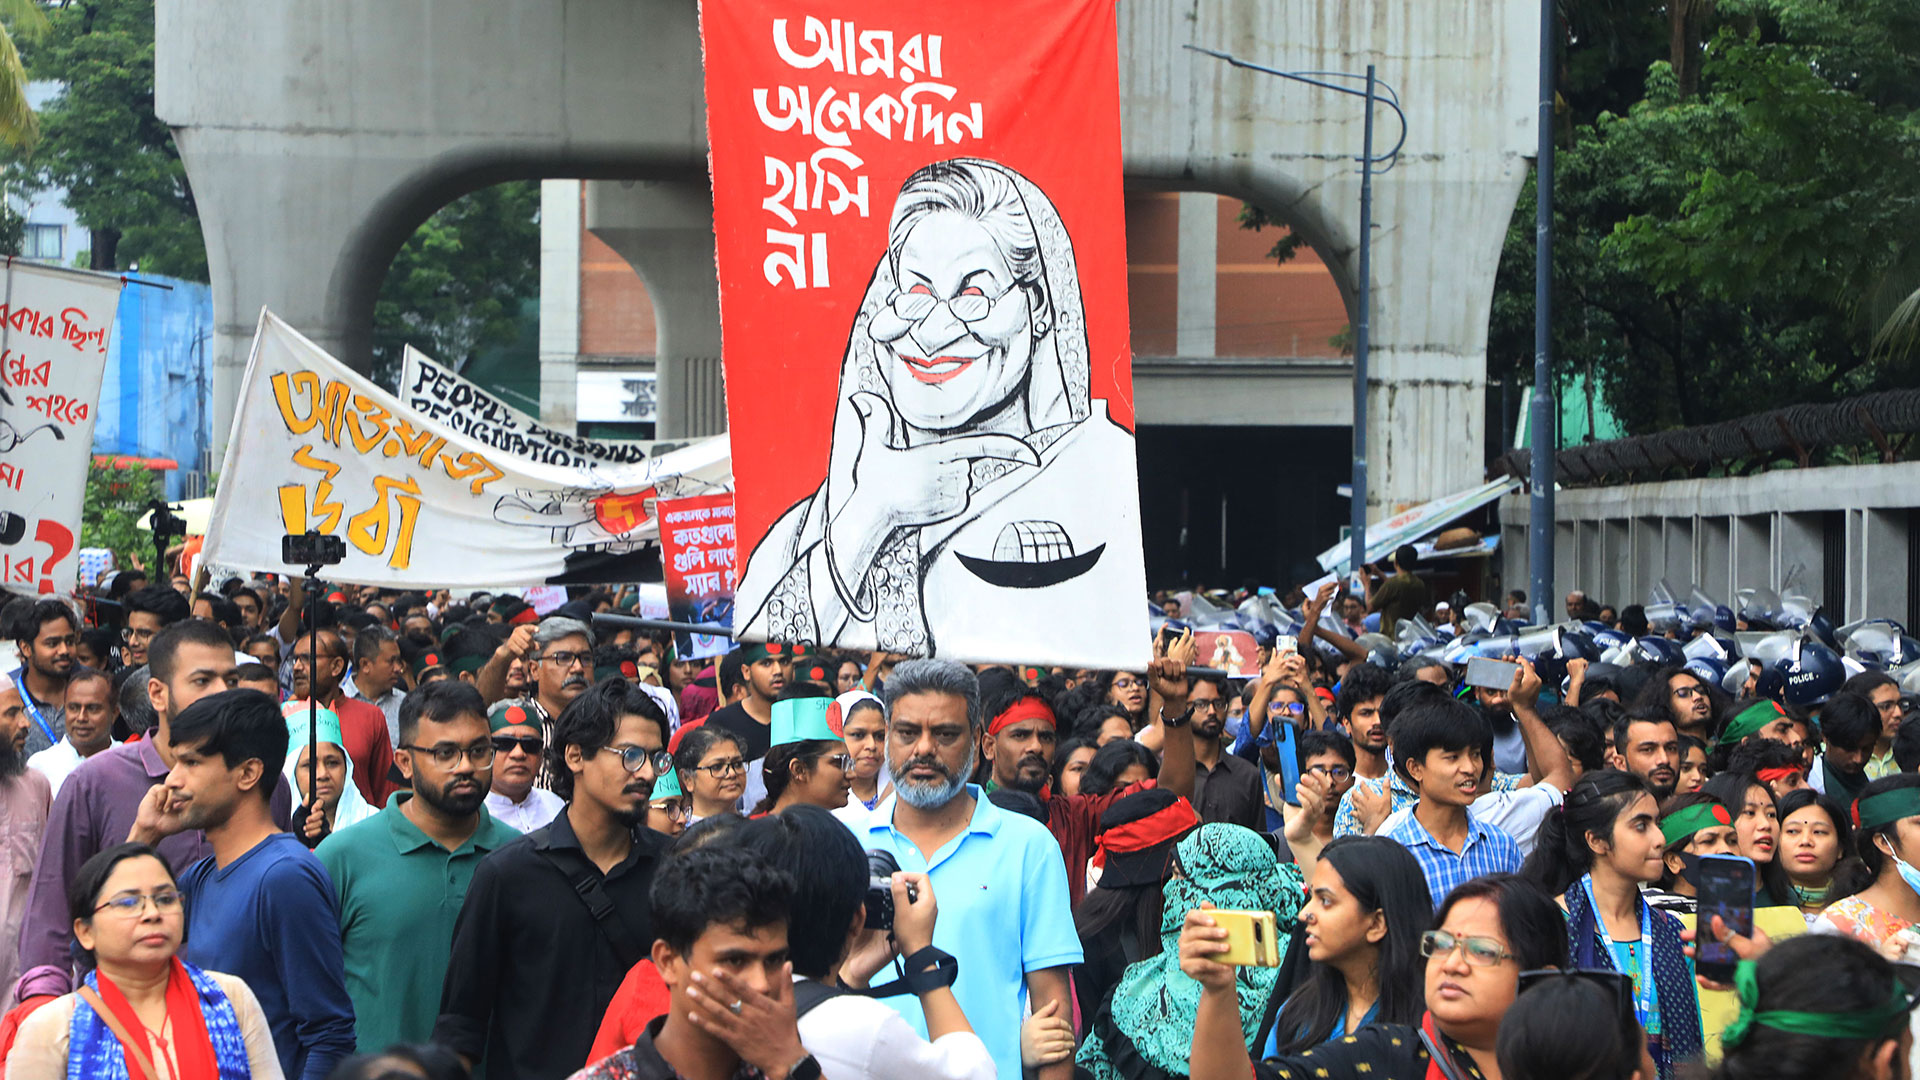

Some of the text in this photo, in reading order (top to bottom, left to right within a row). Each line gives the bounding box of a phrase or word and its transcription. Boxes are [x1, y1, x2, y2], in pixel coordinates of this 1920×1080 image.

[772, 15, 943, 83] আমরা
[752, 82, 984, 147] অনেকদিন
[761, 147, 870, 229] হাসি
[763, 228, 831, 290] না
[25, 393, 89, 426] শহরে
[412, 360, 518, 430] PEOPLE
[270, 370, 506, 496] আওয়াজ
[672, 524, 735, 547] কতগুলো
[673, 546, 706, 572] গুলি
[683, 572, 721, 598] স্যার
[1788, 671, 1815, 685] POLICE
